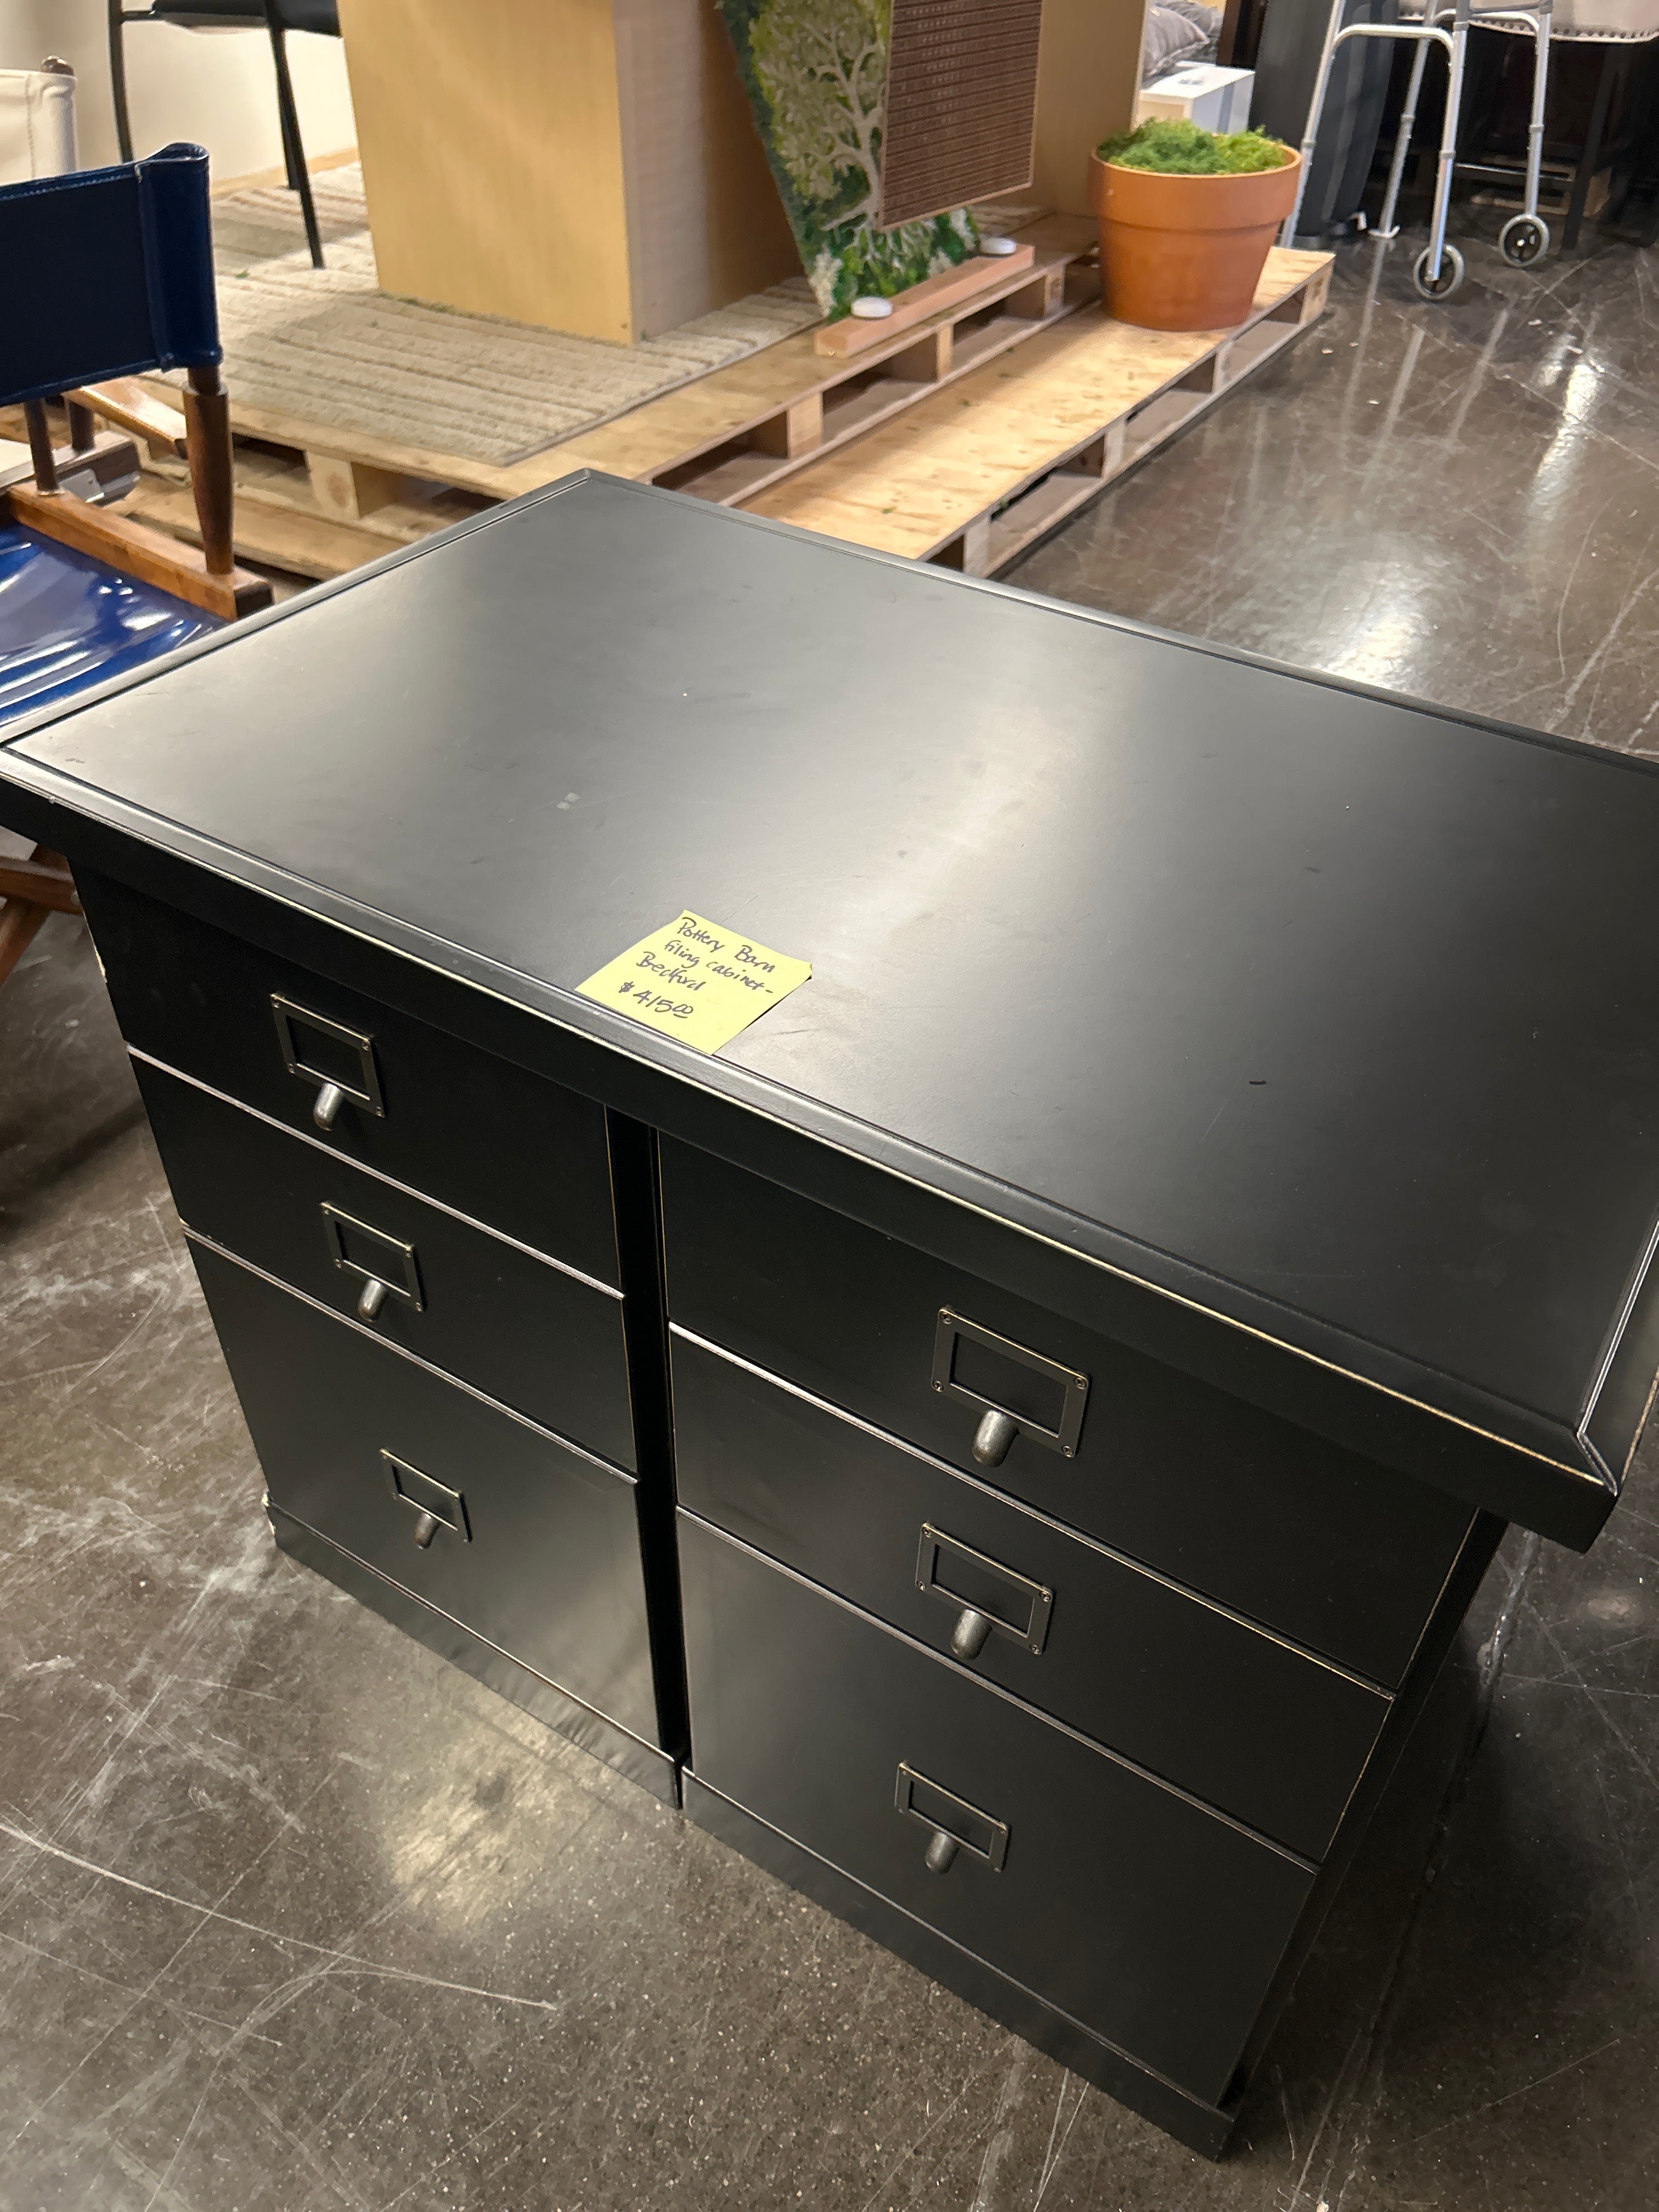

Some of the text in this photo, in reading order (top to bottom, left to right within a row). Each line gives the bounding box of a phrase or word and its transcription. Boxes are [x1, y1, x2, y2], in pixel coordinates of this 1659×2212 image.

[664, 939, 701, 969] filing
[676, 917, 776, 973] Pottery Barn
[636, 951, 707, 991] Bedford
